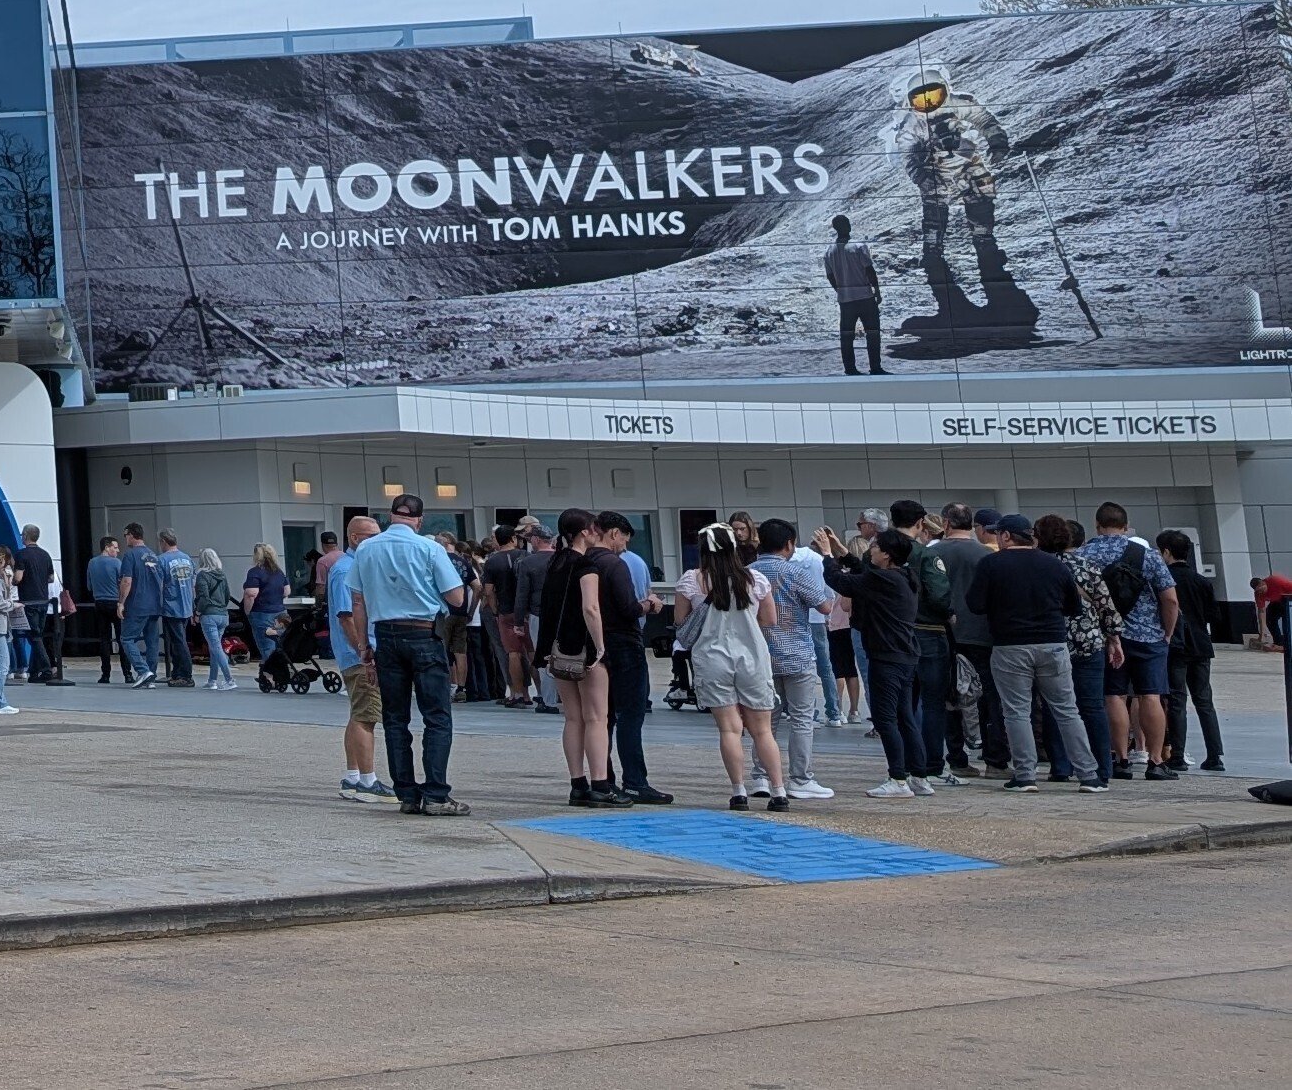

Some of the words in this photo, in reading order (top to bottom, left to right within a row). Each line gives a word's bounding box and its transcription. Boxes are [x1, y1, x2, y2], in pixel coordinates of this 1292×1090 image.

[134, 169, 248, 220] THE
[272, 142, 830, 216] MOONWALKERS
[275, 231, 294, 251] A
[299, 226, 409, 250] JOURNEY
[416, 223, 478, 245] WITH
[487, 215, 561, 242] TOM
[572, 211, 686, 239] HANKS
[604, 414, 675, 435] TICKETS
[942, 416, 1109, 437] SELF-SERVICE
[1111, 415, 1218, 435] TICKETS
